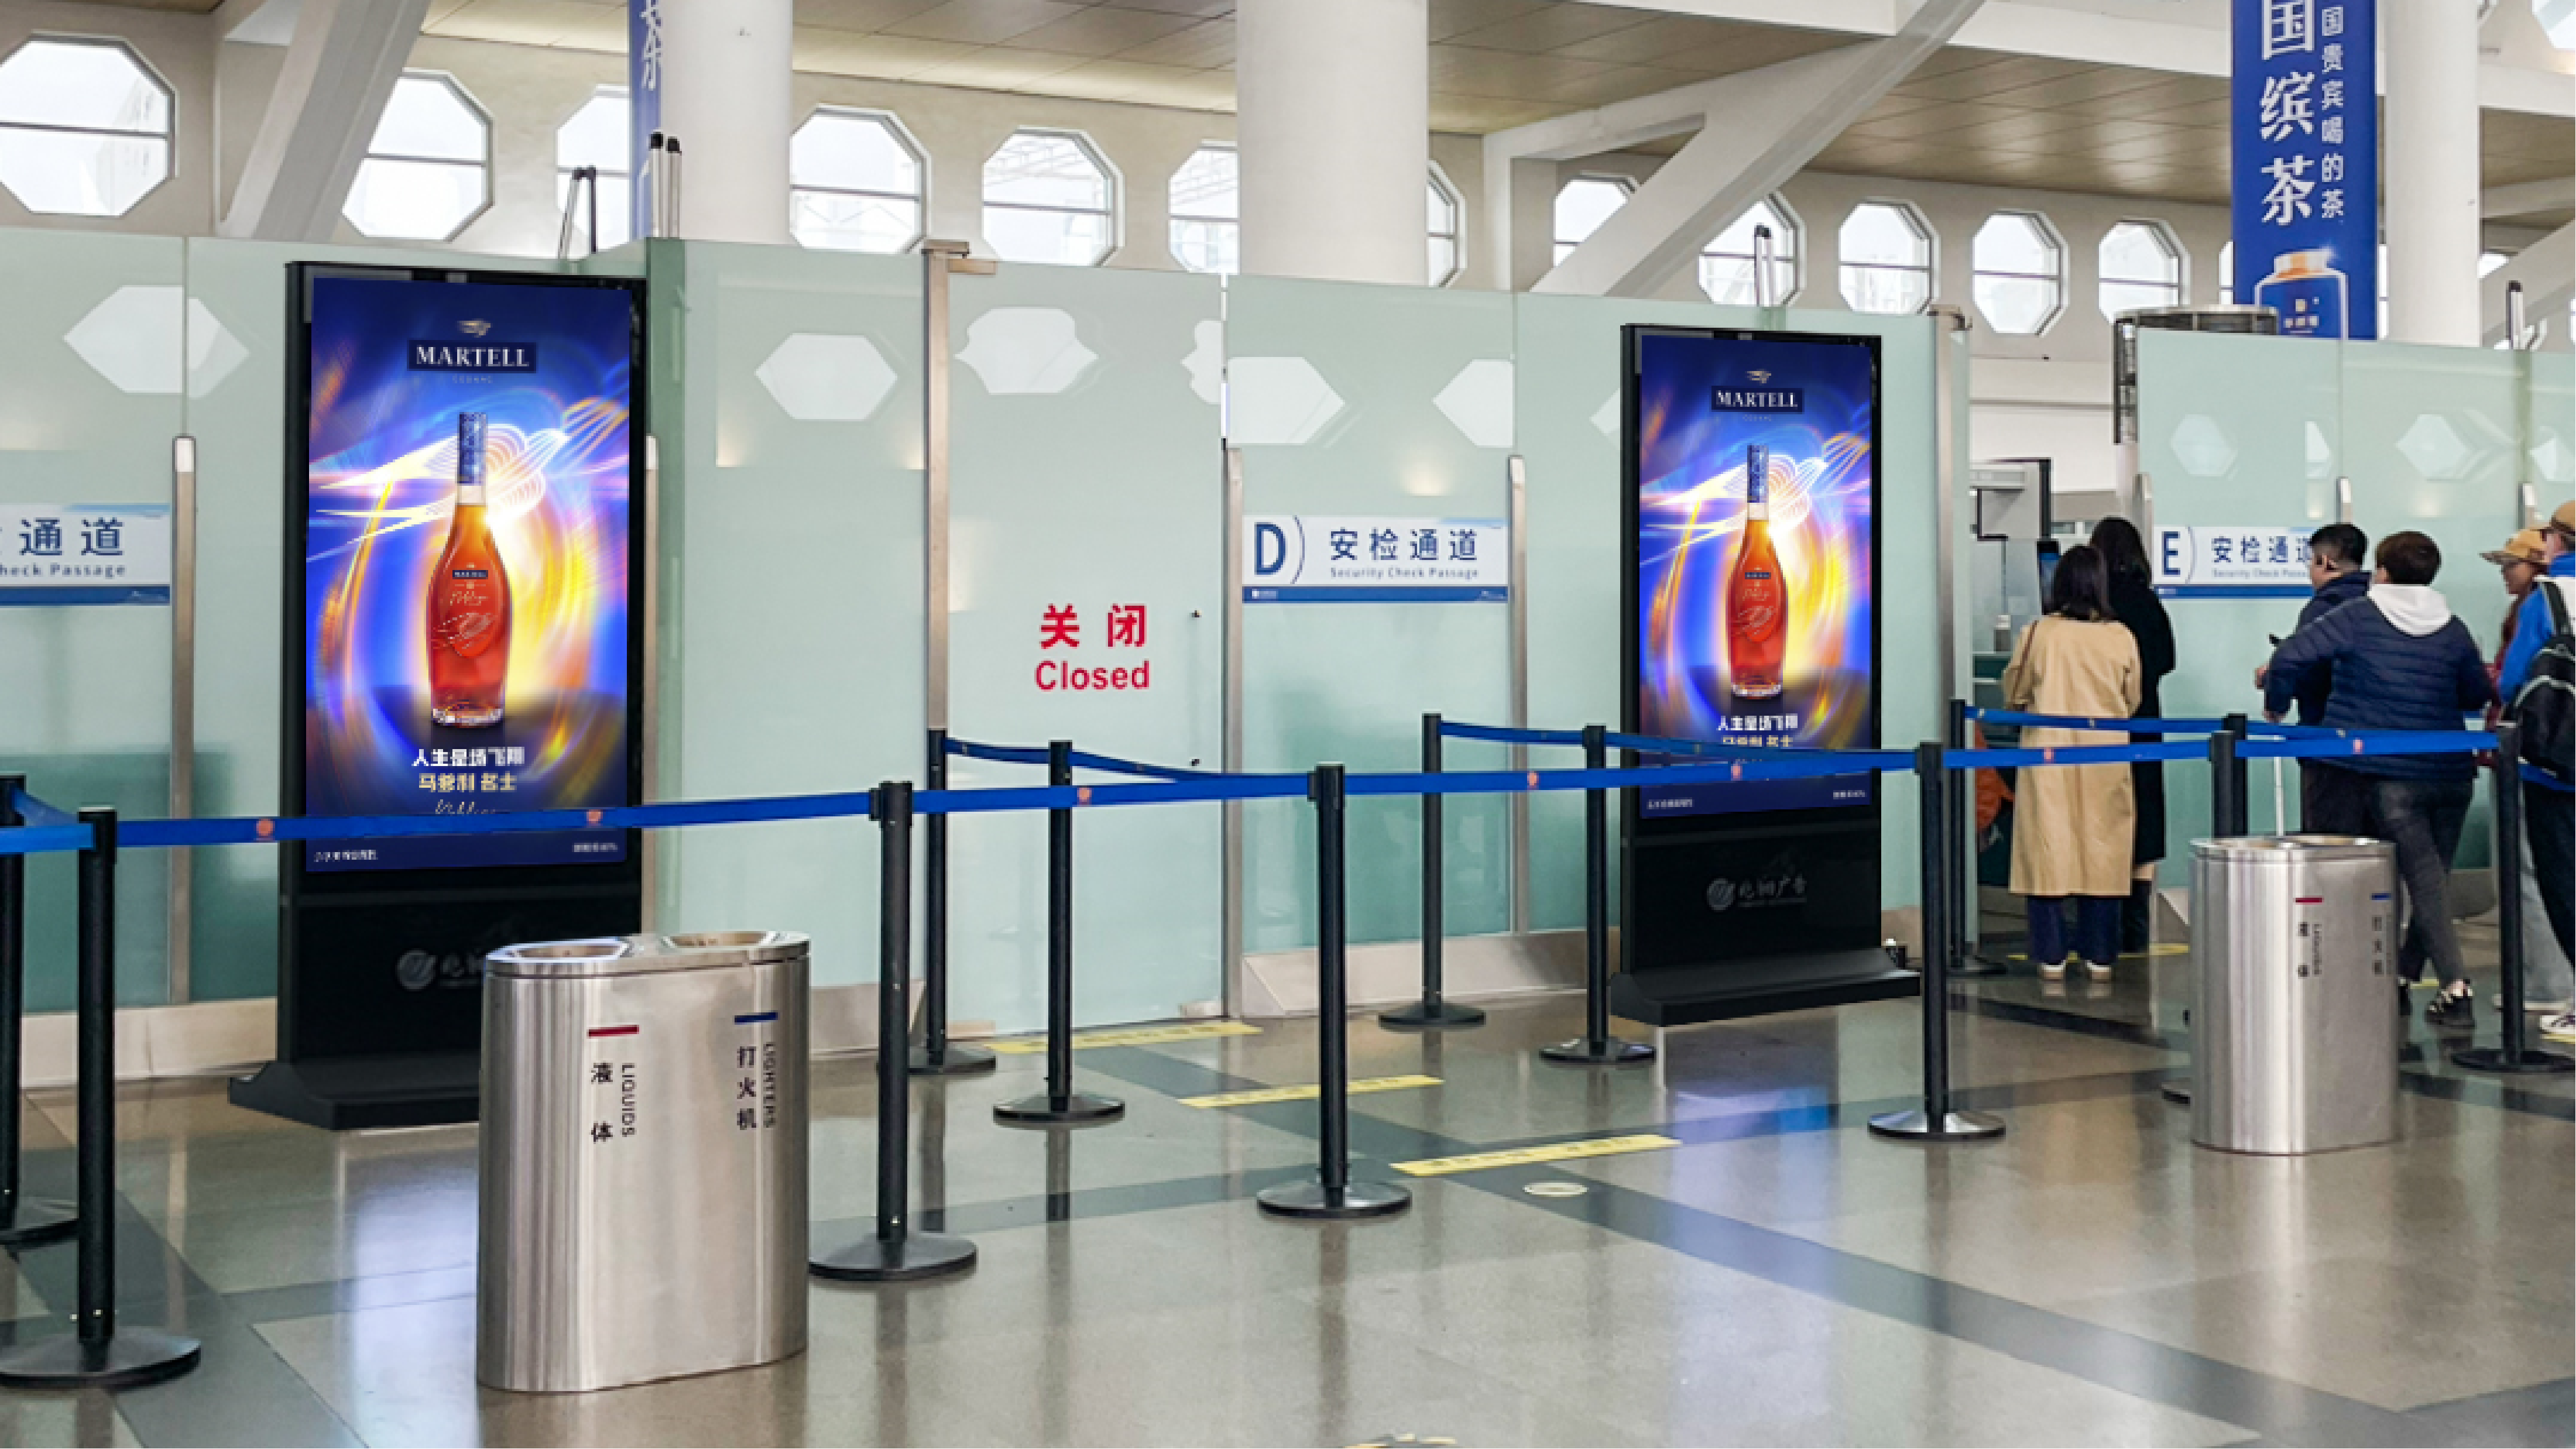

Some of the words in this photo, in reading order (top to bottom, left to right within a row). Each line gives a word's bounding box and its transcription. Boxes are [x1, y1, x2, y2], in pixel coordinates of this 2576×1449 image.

[2321, 6, 2344, 219] 国贵宾喝的茶
[416, 345, 529, 368] MARTELL
[1716, 390, 1798, 407] MARTELL
[0, 517, 124, 556] 通道
[1254, 522, 1287, 575] D
[1330, 527, 1478, 561] 安检通道
[2161, 531, 2181, 575] E
[0, 562, 43, 578] heck
[49, 562, 126, 579] Passage
[1330, 568, 1384, 579] Security
[1388, 568, 1425, 578] Check
[1429, 568, 1479, 580] Passage
[1038, 603, 1148, 649] 关闭
[1034, 658, 1151, 692] Closed
[591, 1061, 613, 1144] 液体
[621, 1063, 636, 1137] LIQUIDS
[736, 1046, 757, 1131] 打火机
